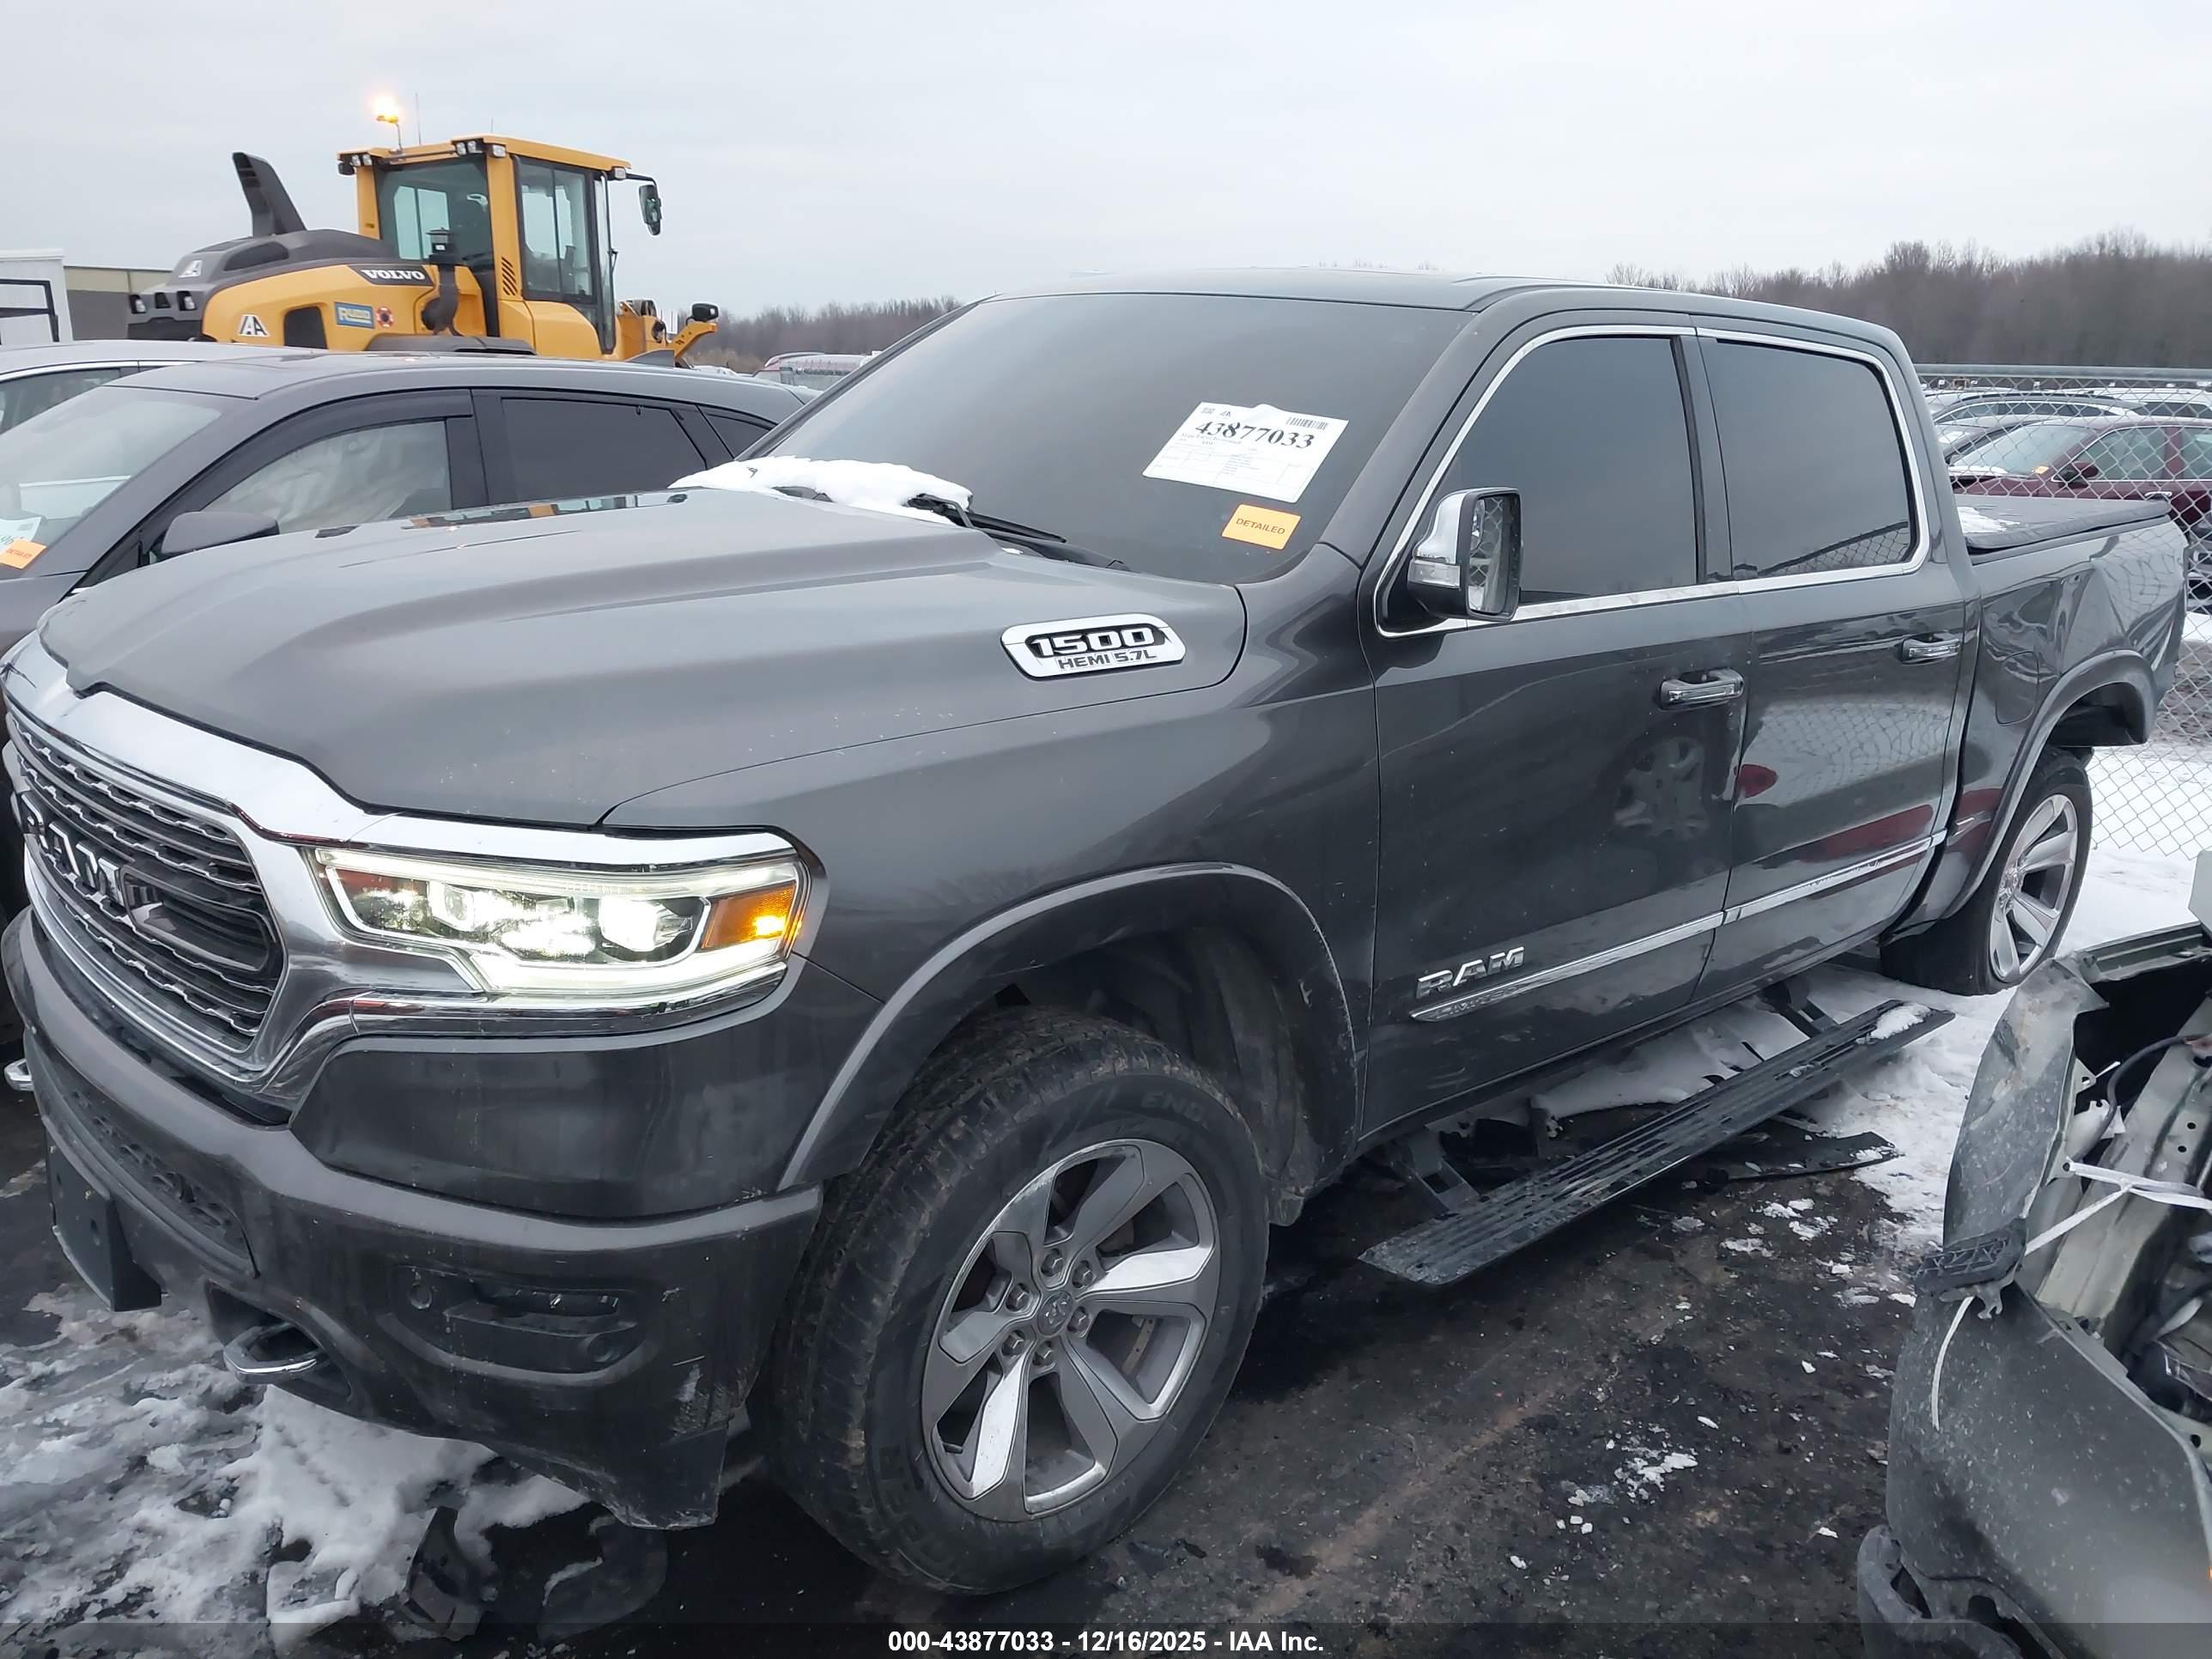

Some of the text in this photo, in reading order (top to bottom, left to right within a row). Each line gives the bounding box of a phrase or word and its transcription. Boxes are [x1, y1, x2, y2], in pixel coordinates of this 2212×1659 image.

[361, 269, 426, 281] VOLVO
[1194, 421, 1315, 449] 43877033
[1235, 517, 1286, 536] DETAILED
[1030, 627, 1155, 657] 1500
[1058, 649, 1158, 670] HEMI 5.7L
[1416, 945, 1525, 1000] RAM
